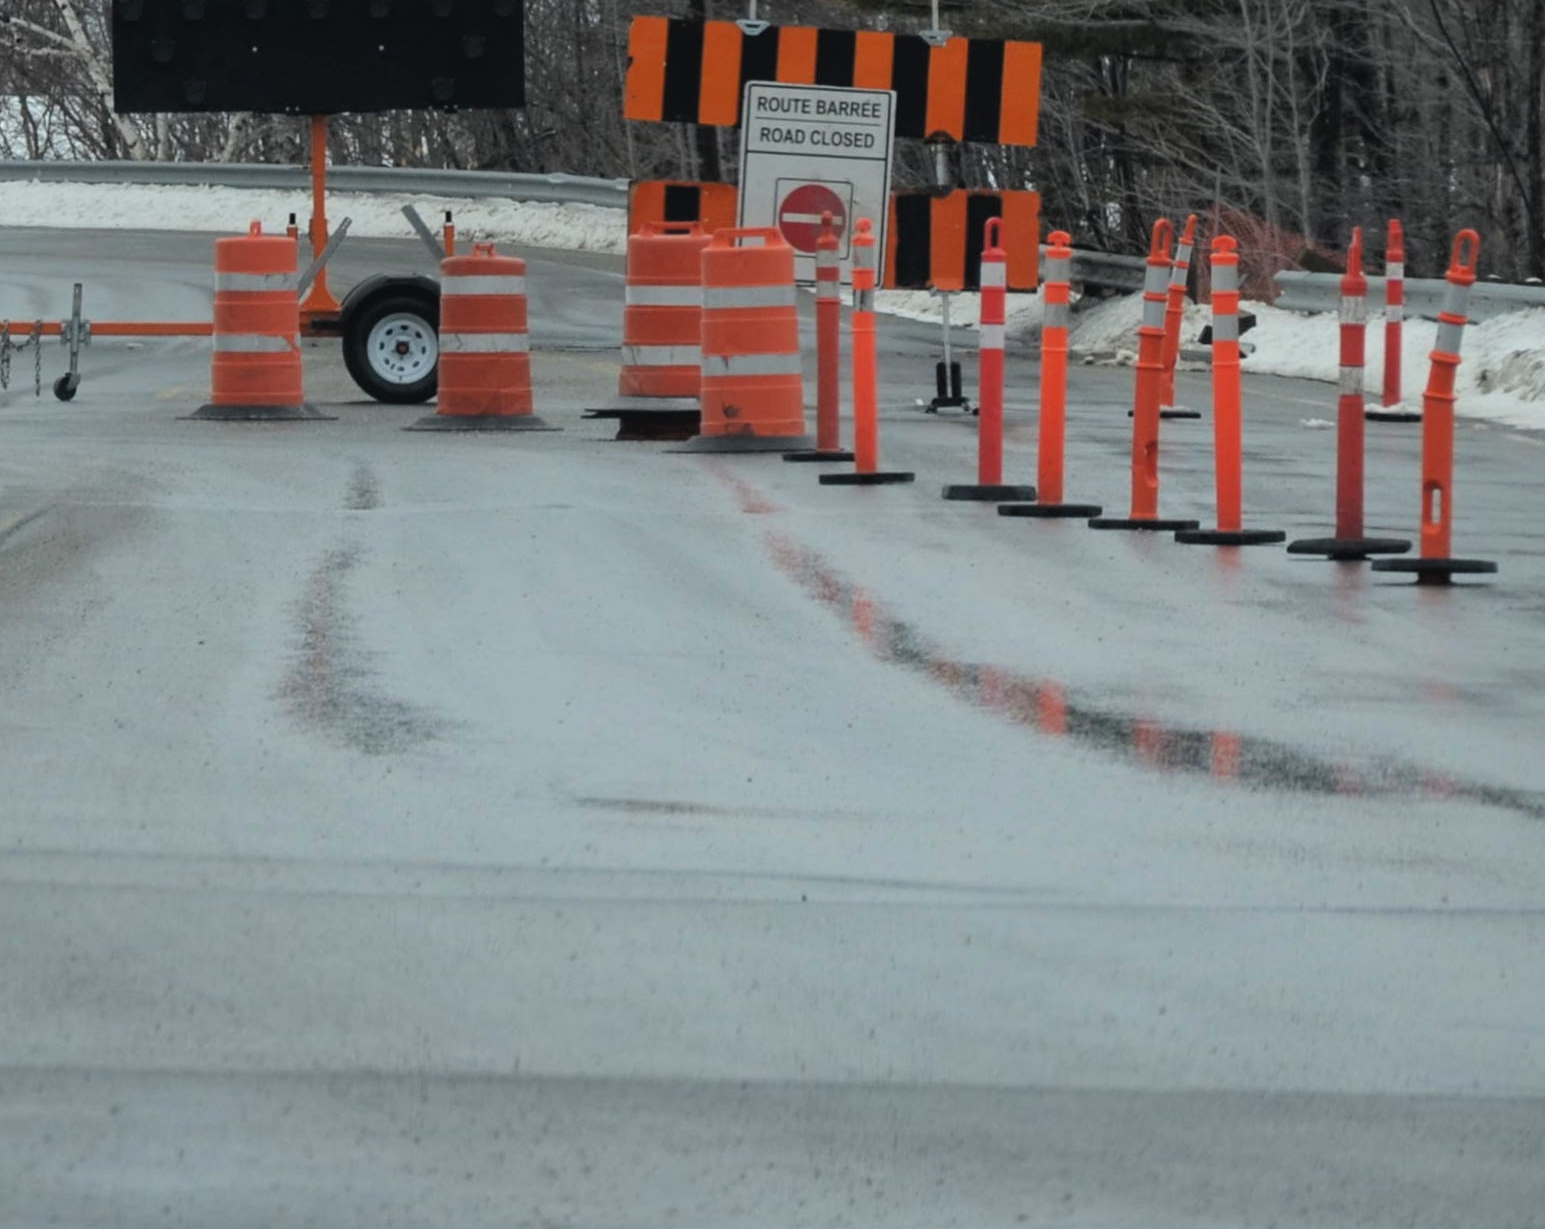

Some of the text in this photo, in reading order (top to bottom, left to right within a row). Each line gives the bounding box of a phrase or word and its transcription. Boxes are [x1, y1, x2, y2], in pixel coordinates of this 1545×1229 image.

[757, 96, 881, 118] ROUTE BARRÉE
[760, 127, 875, 149] ROAD CLOSED
